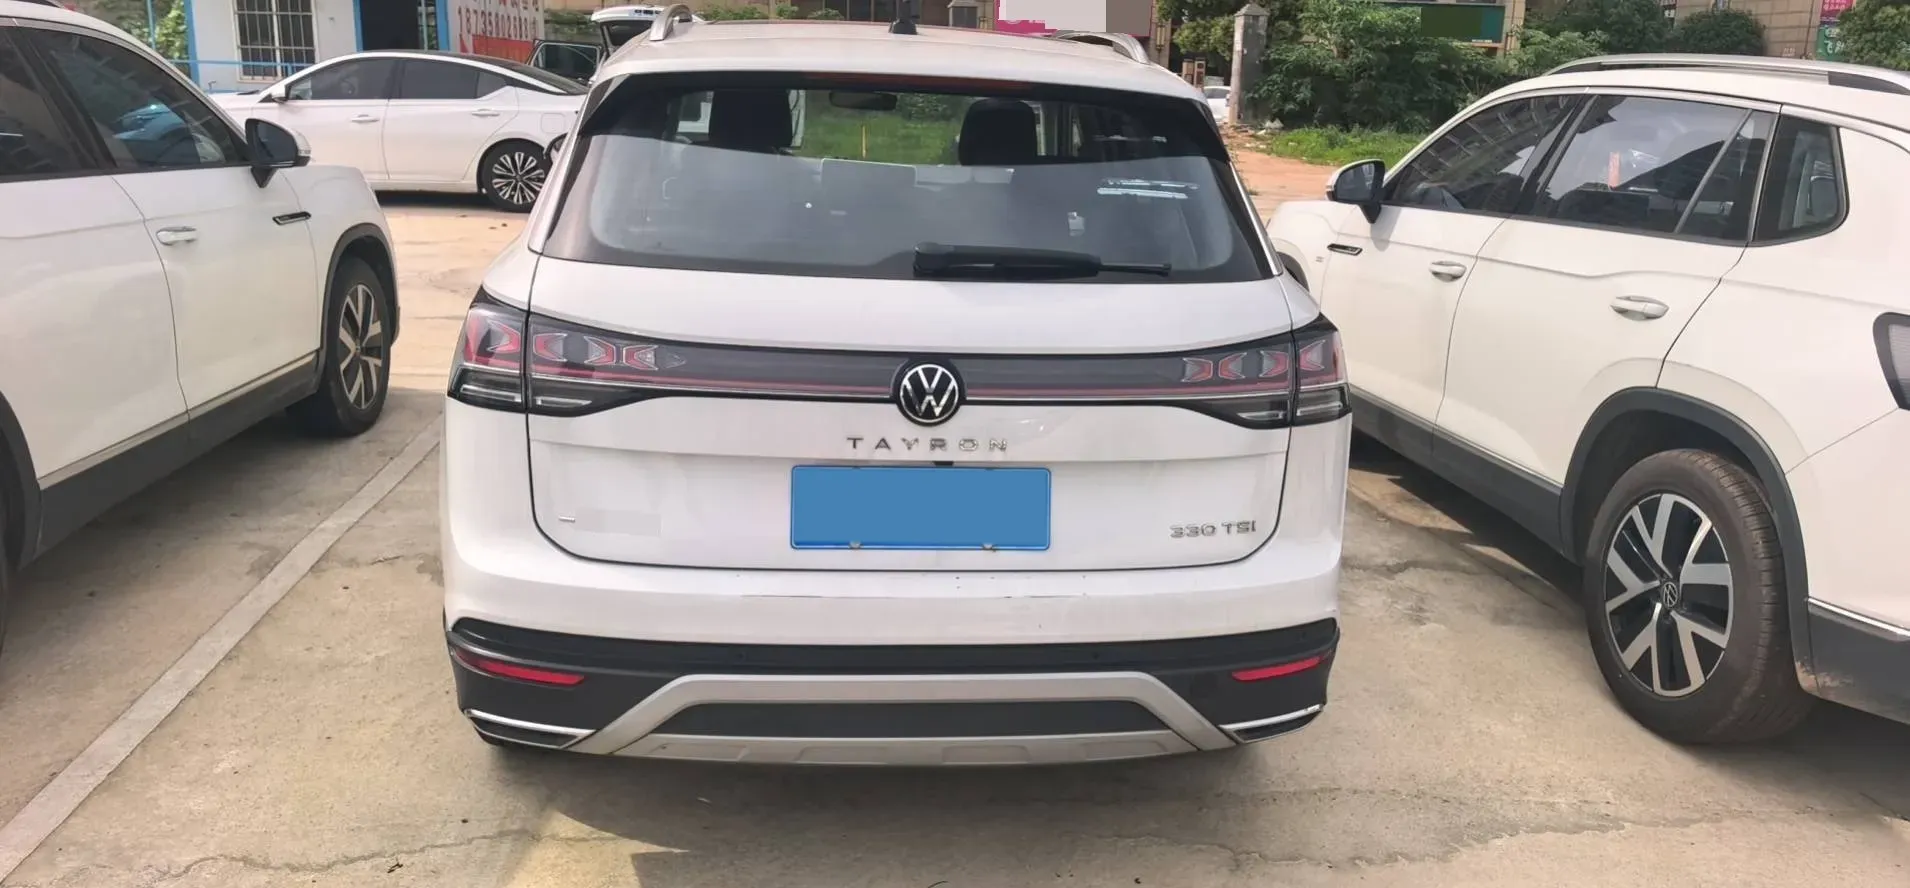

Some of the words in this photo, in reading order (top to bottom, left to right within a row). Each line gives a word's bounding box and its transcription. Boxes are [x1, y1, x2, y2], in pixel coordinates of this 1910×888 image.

[900, 364, 959, 423] VW
[846, 436, 1008, 451] TAYRON
[1169, 523, 1217, 538] 330
[1221, 520, 1256, 535] TSI
